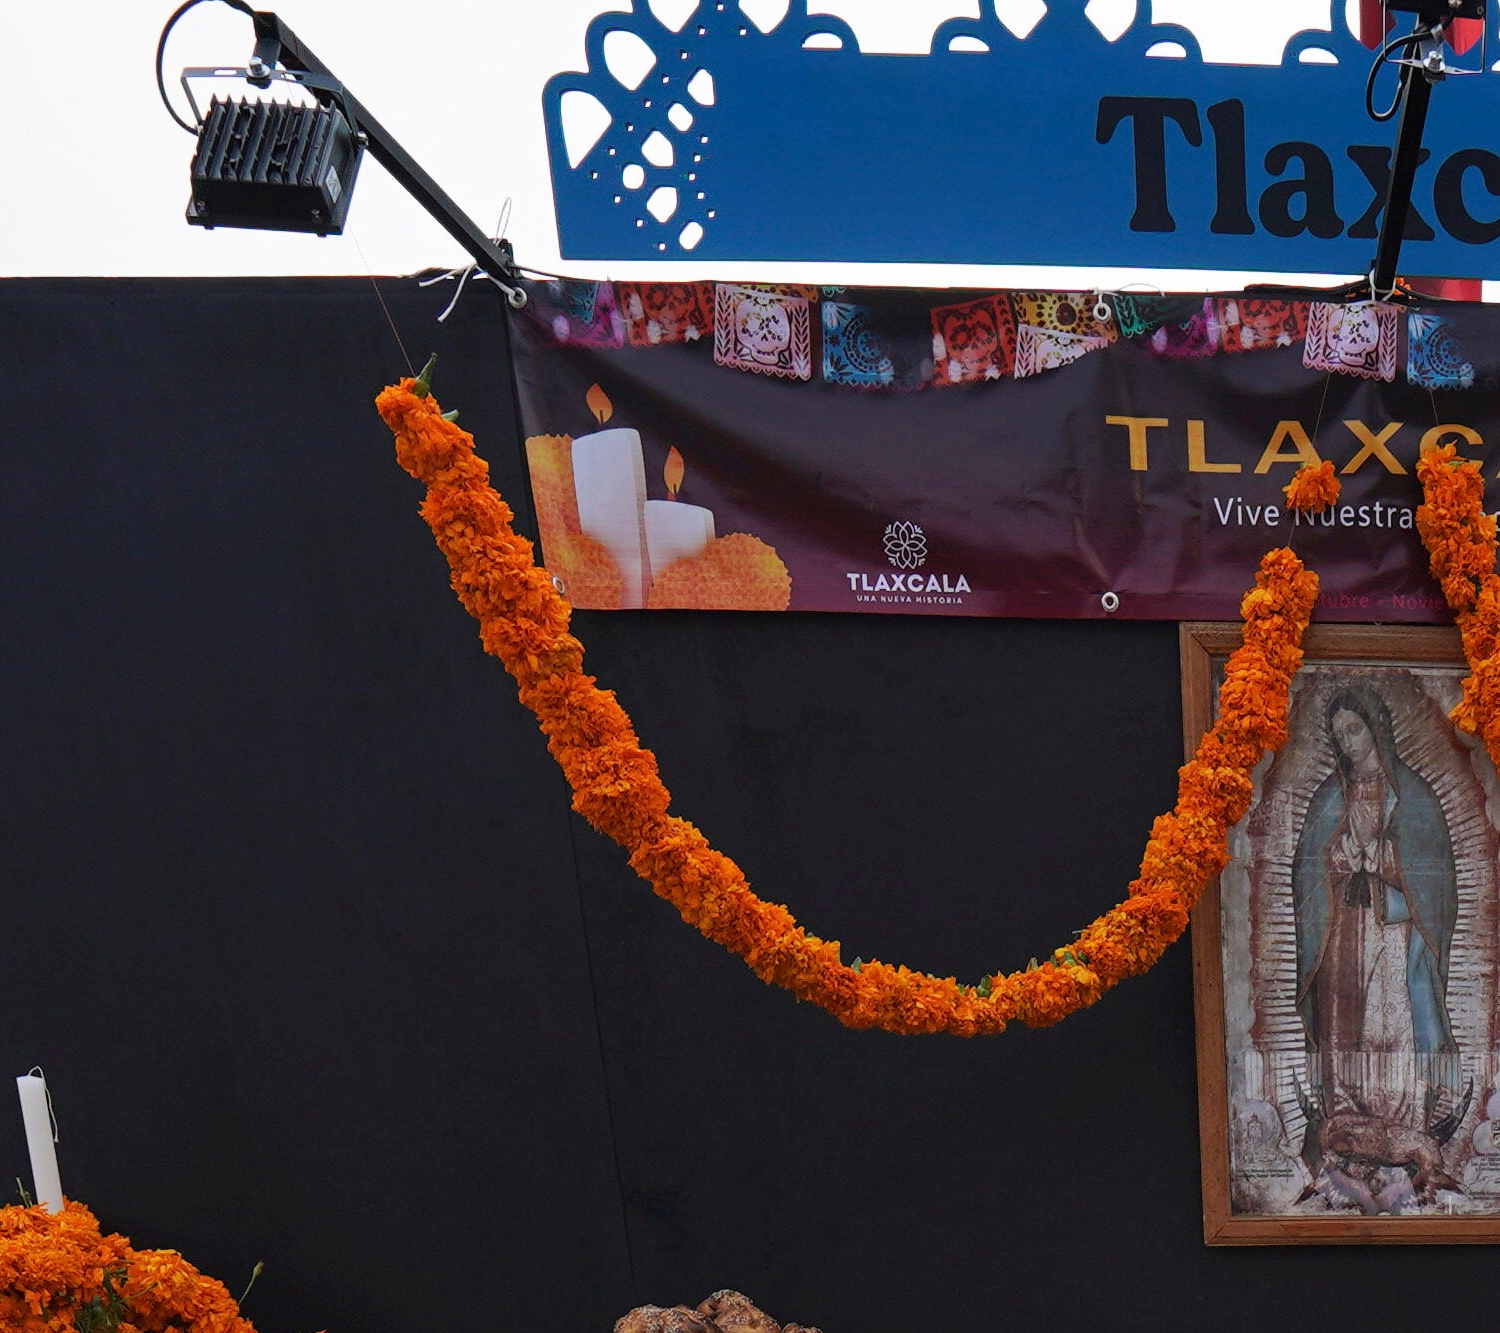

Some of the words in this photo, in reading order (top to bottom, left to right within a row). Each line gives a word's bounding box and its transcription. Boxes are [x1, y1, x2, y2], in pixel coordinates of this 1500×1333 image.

[1213, 497, 1279, 526] Vive
[1296, 503, 1415, 530] Nuestra
[846, 572, 972, 593] TLAXCALA
[880, 595, 912, 603] NUEVA
[916, 596, 963, 604] HISTORIA
[1320, 594, 1368, 609] tubre
[1392, 594, 1443, 610] Novie
